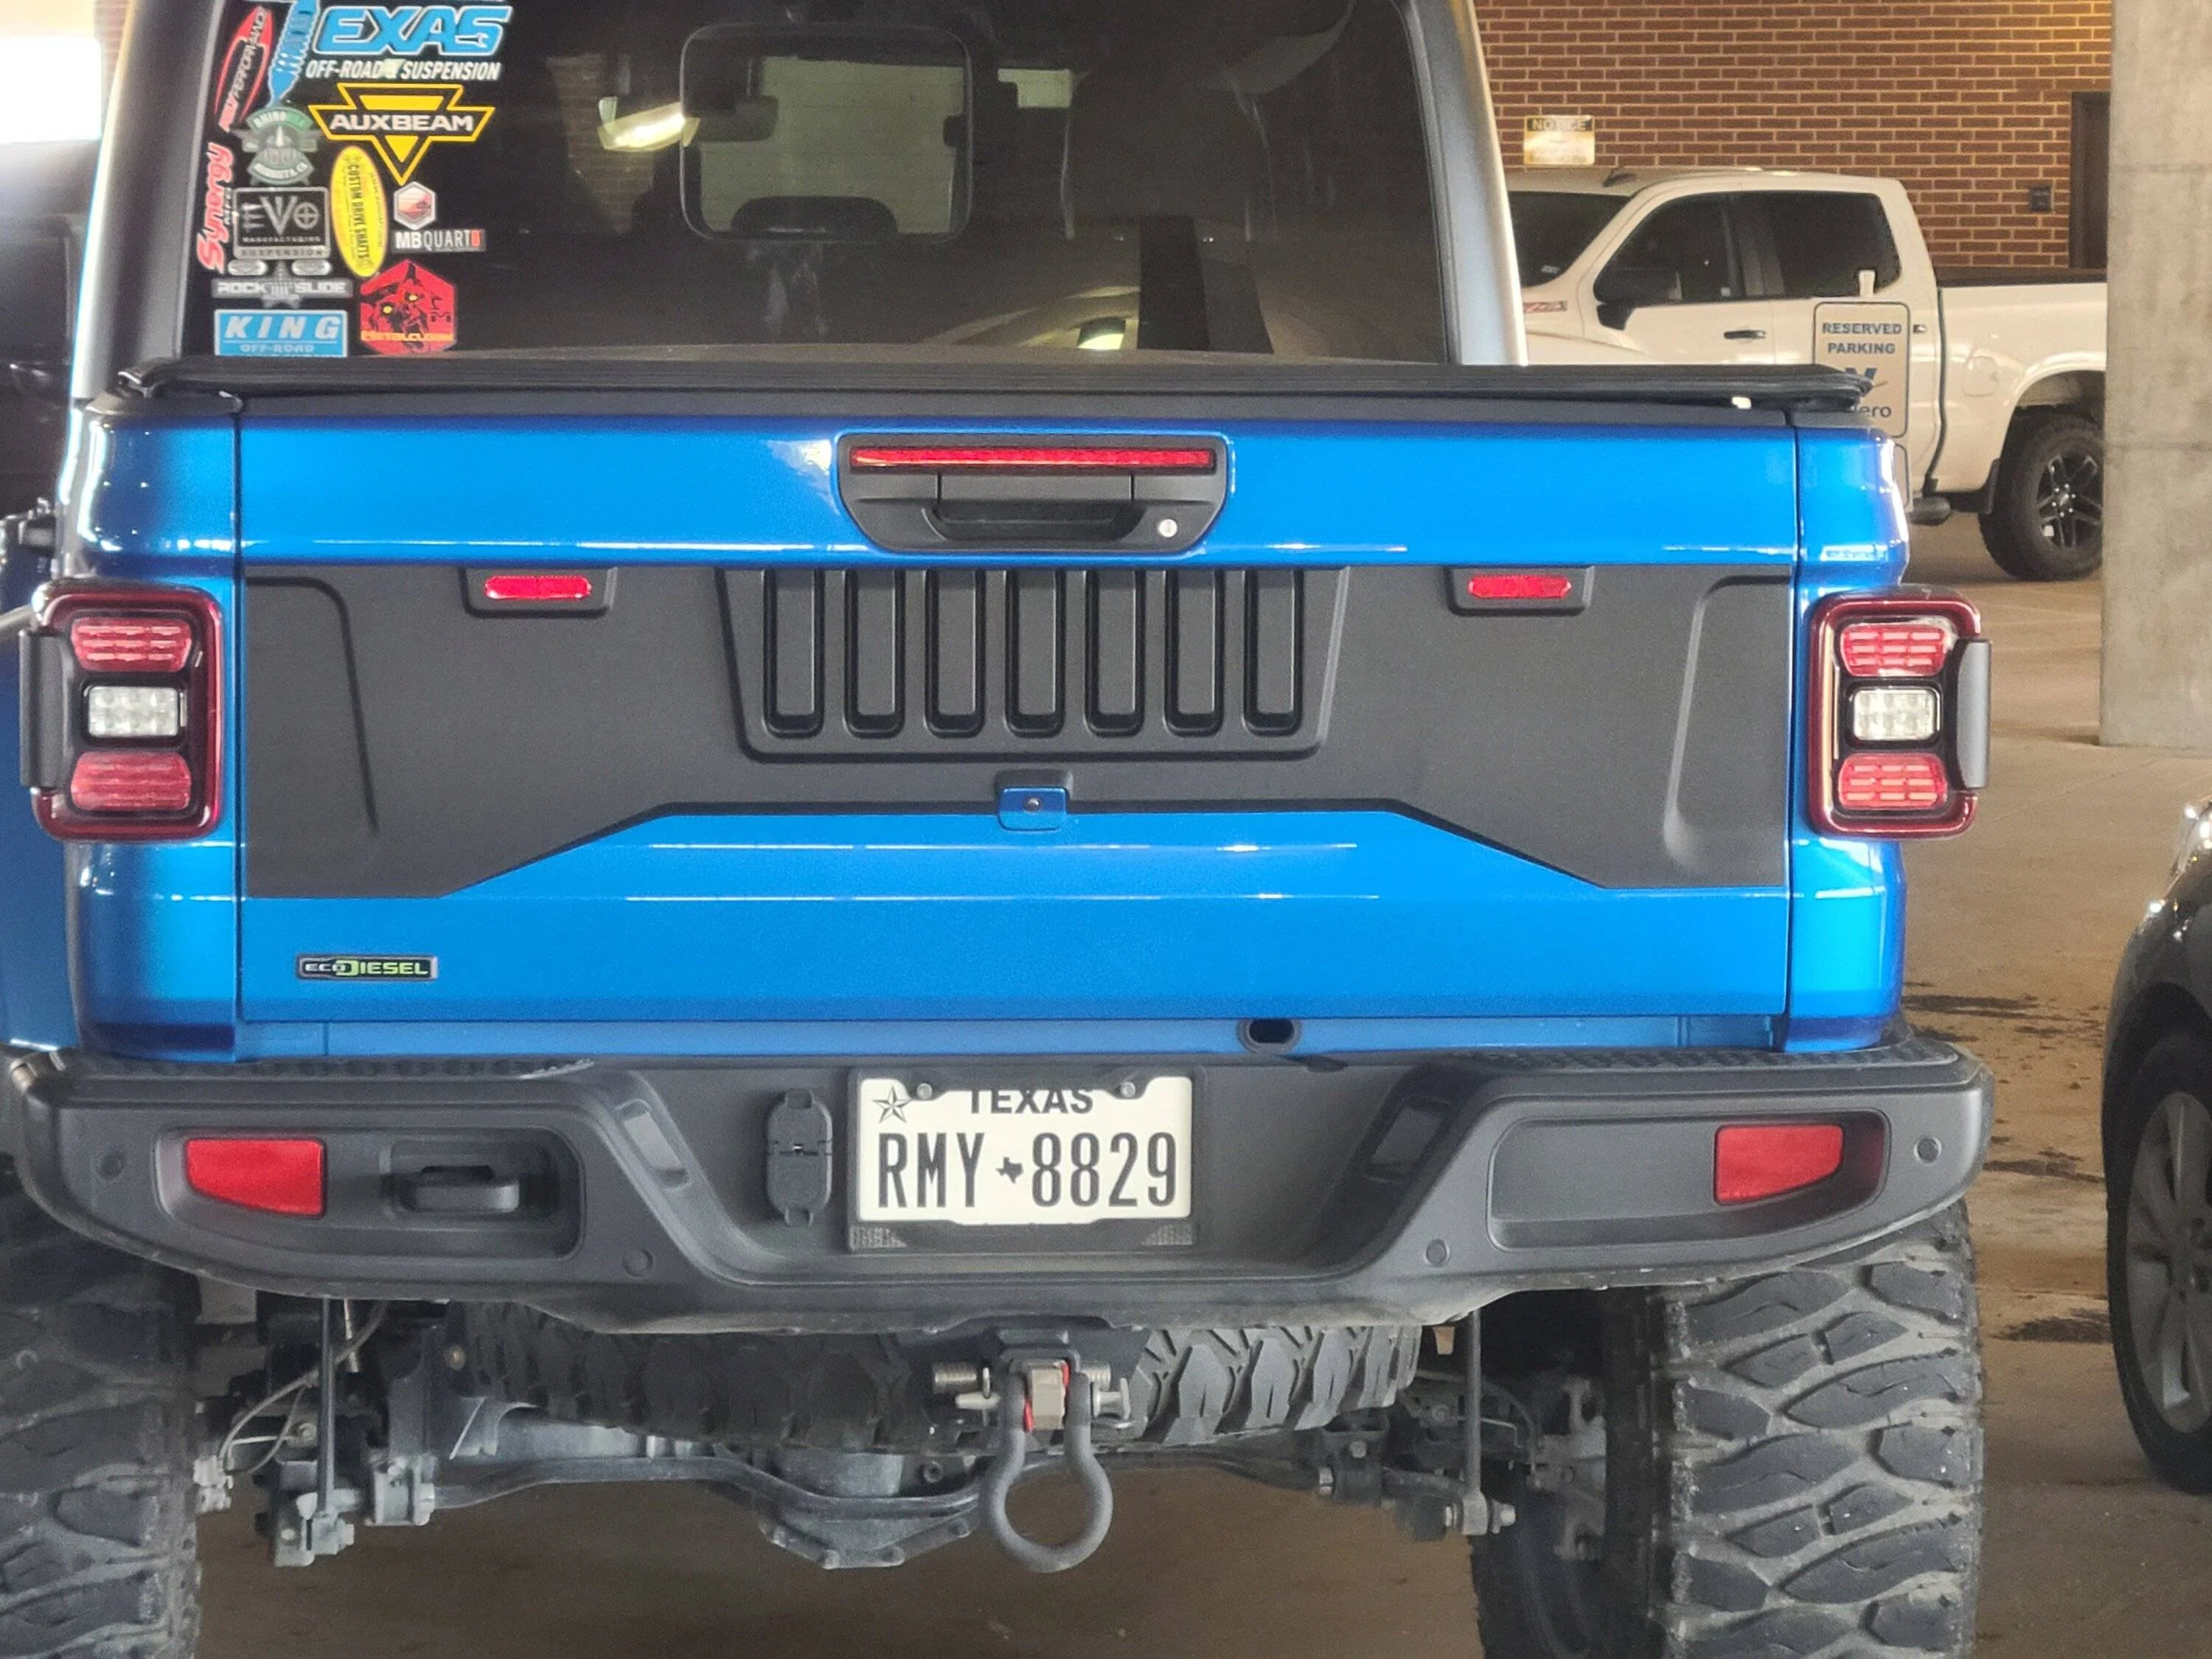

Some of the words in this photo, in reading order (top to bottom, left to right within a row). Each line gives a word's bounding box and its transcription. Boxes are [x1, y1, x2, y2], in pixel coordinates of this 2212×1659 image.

[305, 60, 382, 79] OFF-ROAD
[400, 60, 502, 81] SUSPENSION
[330, 114, 473, 131] AUXBEAM
[347, 164, 363, 199] CUSTOM
[197, 142, 234, 274] Synergy
[241, 195, 320, 236] EVO
[351, 202, 366, 226] DRIVE
[218, 282, 267, 293] ROCK
[295, 282, 347, 294] SLIDE
[223, 315, 341, 340] KING
[1822, 322, 1902, 335] RESERVED
[240, 344, 315, 352] OFF-ROAD
[1827, 342, 1896, 355] PARKING
[970, 1089, 1094, 1115] TEXAS
[877, 1132, 985, 1208] RMY
[1032, 1132, 1178, 1208] 8829
